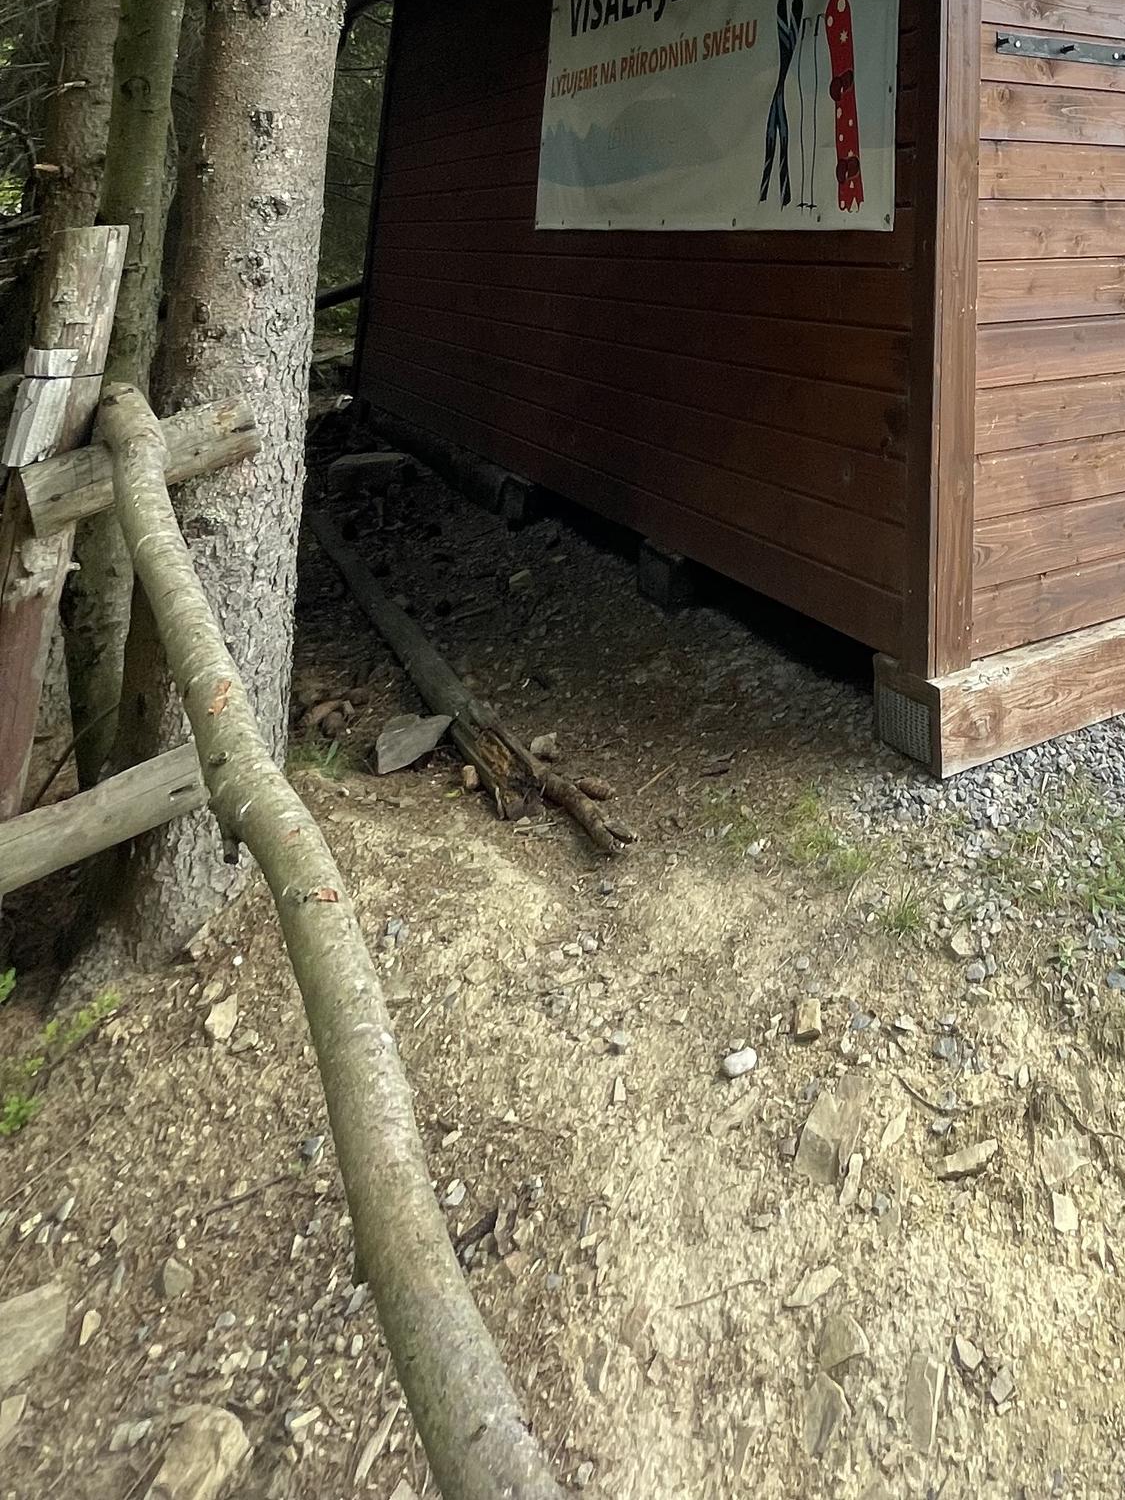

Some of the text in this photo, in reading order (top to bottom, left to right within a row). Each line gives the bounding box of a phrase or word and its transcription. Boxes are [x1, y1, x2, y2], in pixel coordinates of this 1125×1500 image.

[551, 19, 758, 99] LYŽUJEME NA PŘÍRODNÍM SNĚHU
